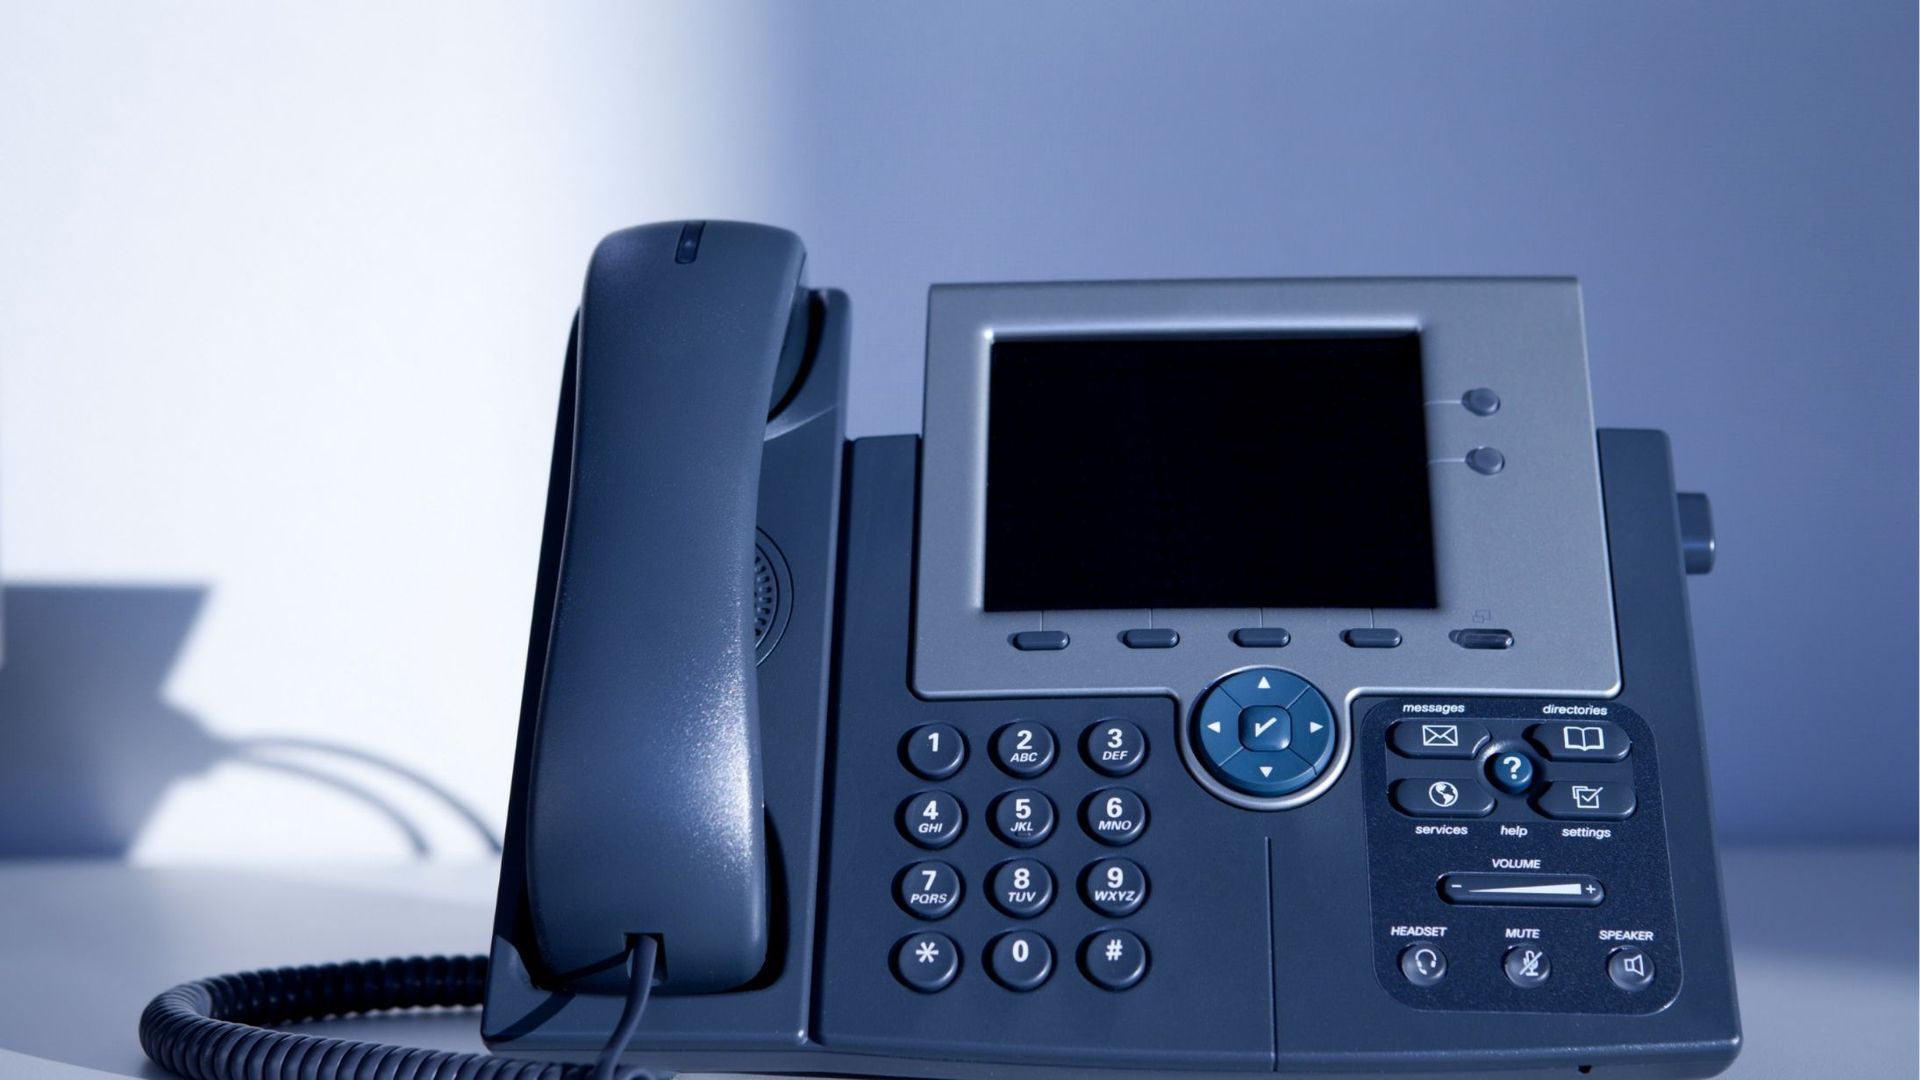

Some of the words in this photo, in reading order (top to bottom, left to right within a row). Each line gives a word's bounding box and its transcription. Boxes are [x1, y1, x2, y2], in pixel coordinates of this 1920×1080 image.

[1402, 704, 1465, 715] messages
[1542, 704, 1608, 716] directories
[928, 732, 940, 752] 1
[1016, 730, 1033, 750] 2
[1107, 728, 1123, 749] 3
[1010, 752, 1038, 763] ABC
[1102, 750, 1129, 761] DEF
[1503, 756, 1522, 780] ?
[923, 800, 939, 821] 4
[1015, 798, 1032, 820] 5
[1106, 797, 1123, 819] 6
[918, 822, 943, 834] GHI
[1010, 821, 1034, 832] JKL
[1098, 820, 1132, 831] MNO
[1414, 824, 1468, 836] services
[1500, 825, 1528, 838] help
[1561, 826, 1612, 840] settings
[1491, 858, 1542, 869] VOLUME
[922, 870, 937, 891] 7
[1013, 867, 1030, 890] 8
[1107, 866, 1124, 889] 9
[910, 893, 948, 905] PQRS
[1008, 891, 1037, 903] TUV
[1094, 890, 1136, 902] WXYZ
[1390, 926, 1448, 937] HEADSET
[1505, 928, 1541, 939] MUTE
[1598, 930, 1654, 941] SPEAKER
[1012, 939, 1029, 963] 0
